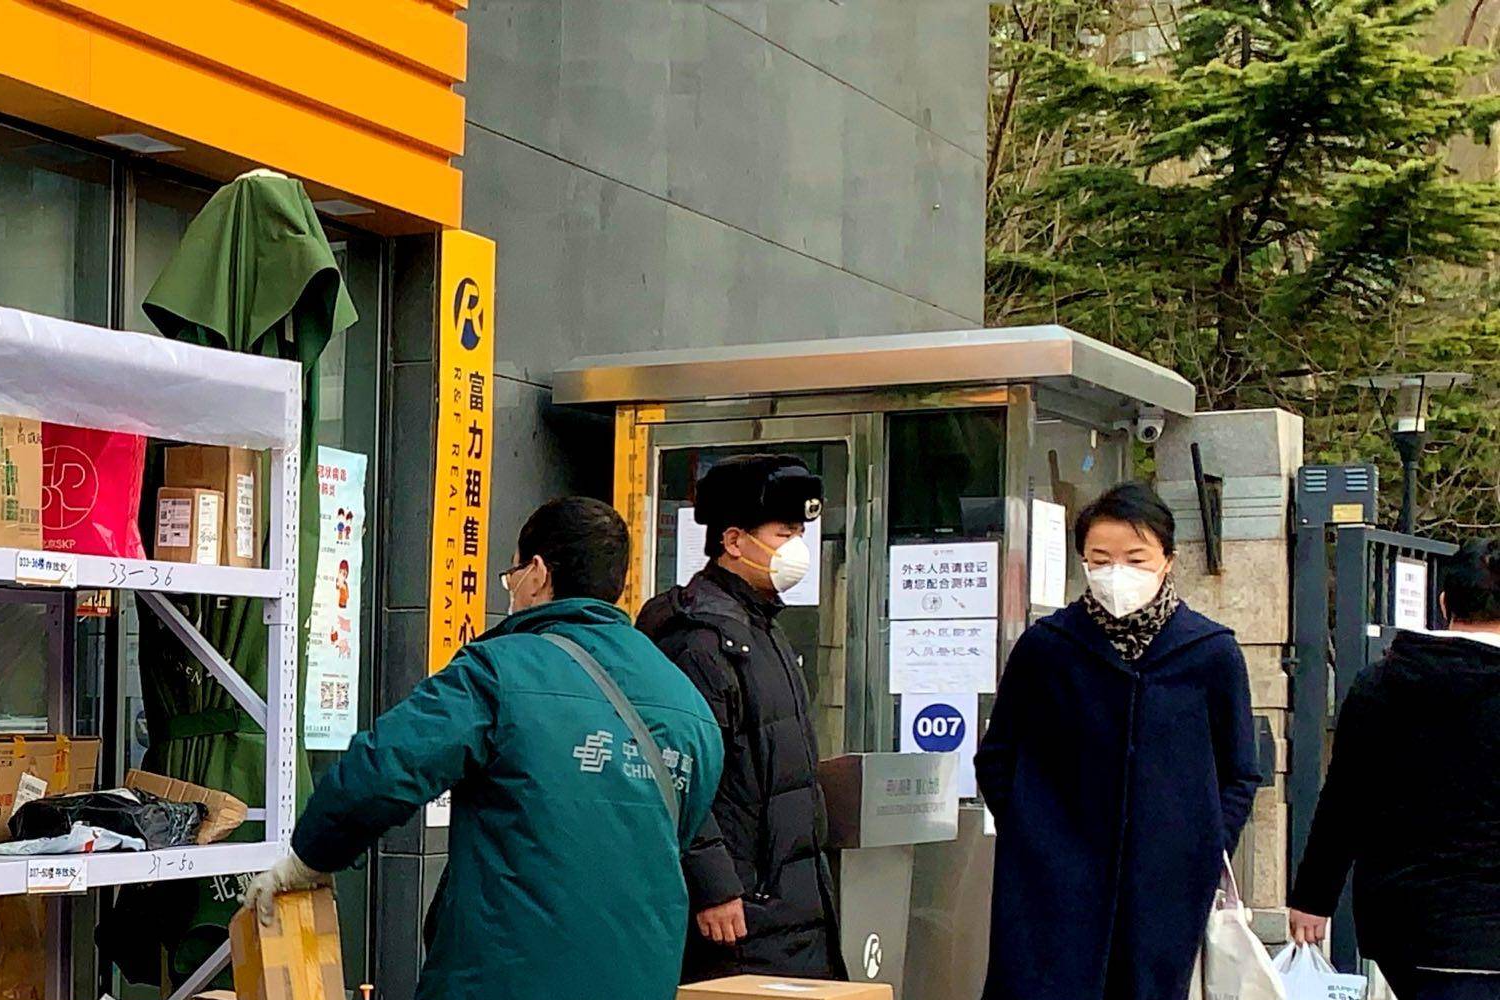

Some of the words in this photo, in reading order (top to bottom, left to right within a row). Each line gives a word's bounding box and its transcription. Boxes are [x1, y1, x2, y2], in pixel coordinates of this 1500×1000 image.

[453, 366, 463, 424] R&F
[448, 443, 461, 518] REAL
[458, 371, 485, 644] 富力租售中心
[108, 562, 173, 587] 33-36
[901, 561, 988, 574] 外来人员请登记
[901, 576, 988, 590] 请您配合测体温
[442, 537, 455, 649] ESTATE
[917, 716, 961, 737] 007
